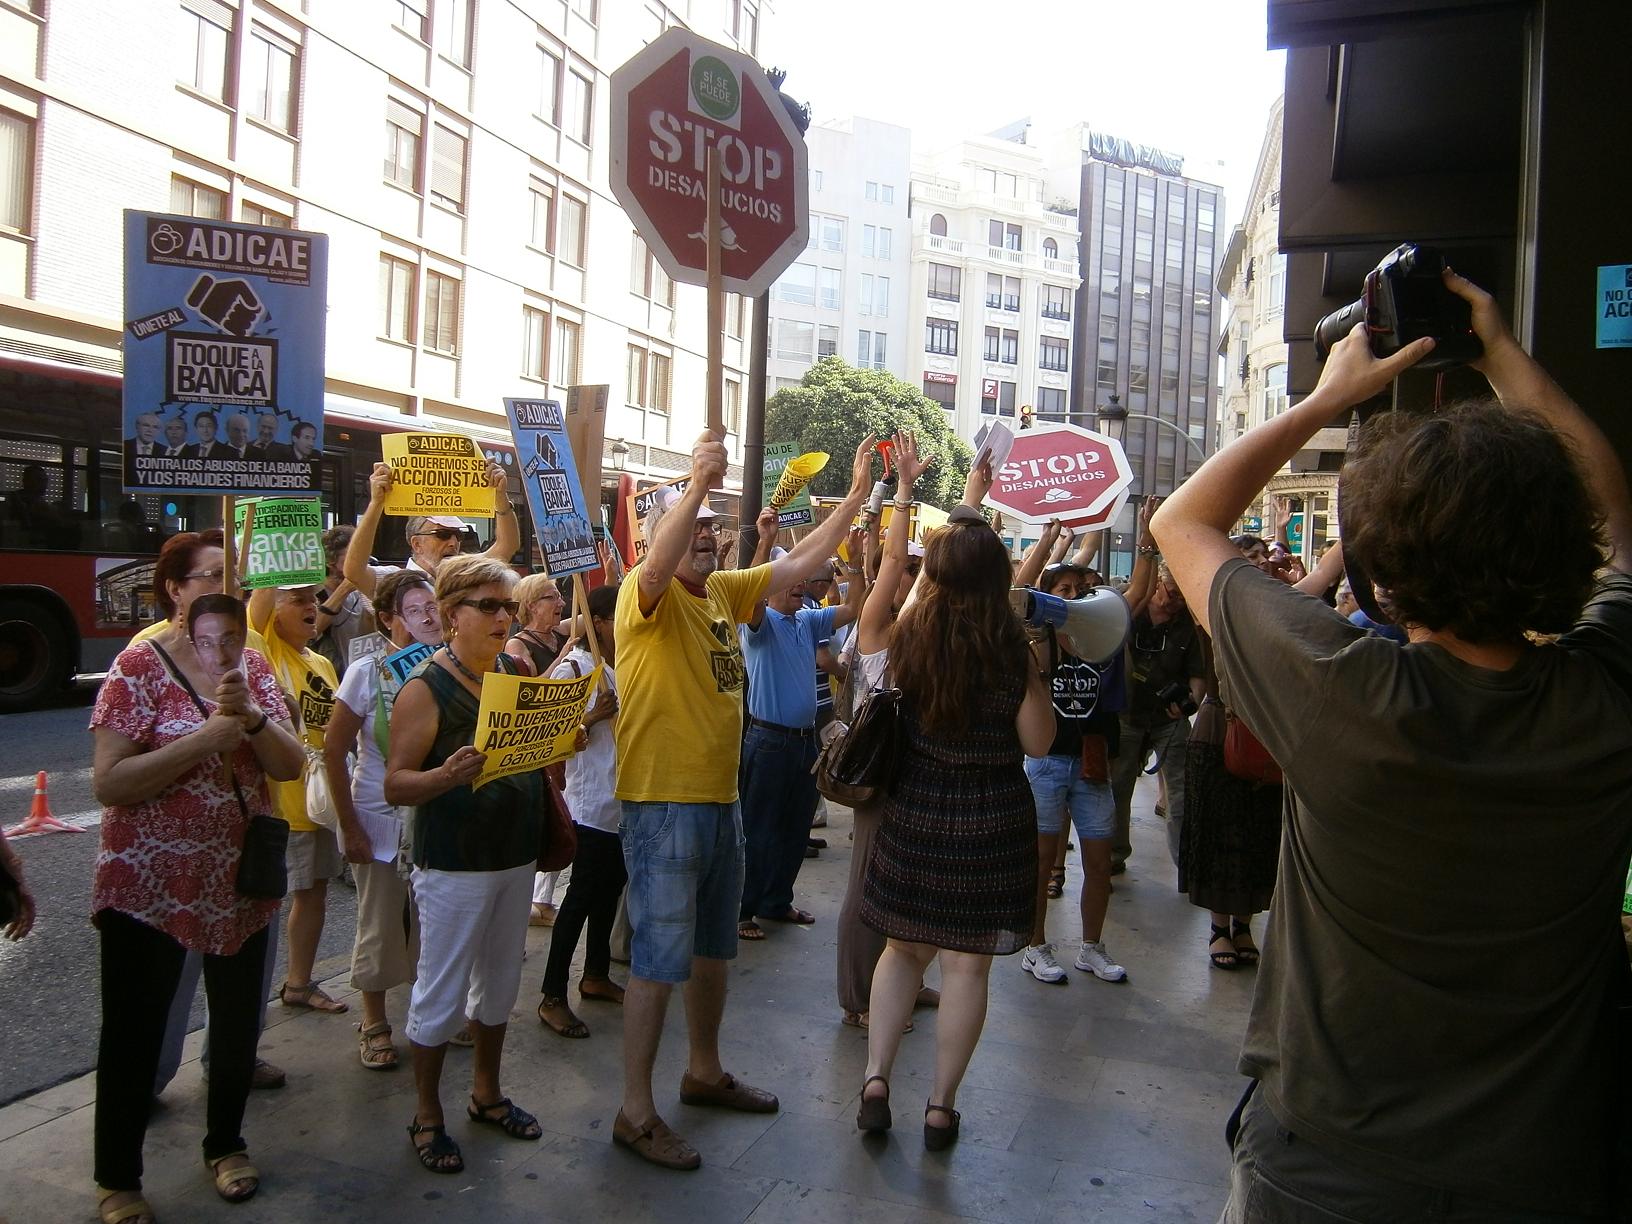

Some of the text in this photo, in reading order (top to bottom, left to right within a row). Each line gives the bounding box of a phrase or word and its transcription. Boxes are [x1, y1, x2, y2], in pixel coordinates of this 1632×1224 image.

[700, 81, 731, 102] PUEDE
[716, 76, 728, 90] SE
[649, 110, 782, 191] STOP
[650, 166, 782, 224] DESAUCIOS
[186, 227, 307, 270] ADICAE
[1605, 290, 1623, 302] NO
[134, 310, 184, 337] ÚNETE AL
[177, 342, 260, 369] TOQUE A
[251, 359, 264, 370] LA
[177, 365, 268, 397] BANCA
[526, 404, 560, 425] ADICAE
[420, 437, 465, 451] ADICAE
[780, 445, 793, 454] DE
[136, 457, 311, 474] CONTRA LOS ABUSOS DE LA BANCA
[391, 457, 408, 468] NO
[410, 457, 468, 470] QUEREMOS
[999, 451, 1100, 482] STOP
[137, 471, 311, 488] Y LOS FRAUDES FINANCIEROS
[391, 469, 489, 488] ACCIONISTAS
[1002, 470, 1106, 493] DESAHUCIOS
[415, 493, 462, 507] Bankia
[422, 486, 451, 494] FORZOSOS
[544, 490, 571, 509] BANCA
[235, 514, 319, 534] PEFERENTES
[778, 512, 803, 523] ADICAE
[249, 532, 319, 554] ankia
[248, 549, 323, 575] RAUDE!
[534, 681, 583, 702] ADICAE
[1053, 677, 1097, 691] STOP
[488, 711, 511, 728] NO
[514, 704, 576, 727] QUEREMOS
[483, 714, 582, 752] ACCIONISTA
[500, 747, 554, 767] Bankia
